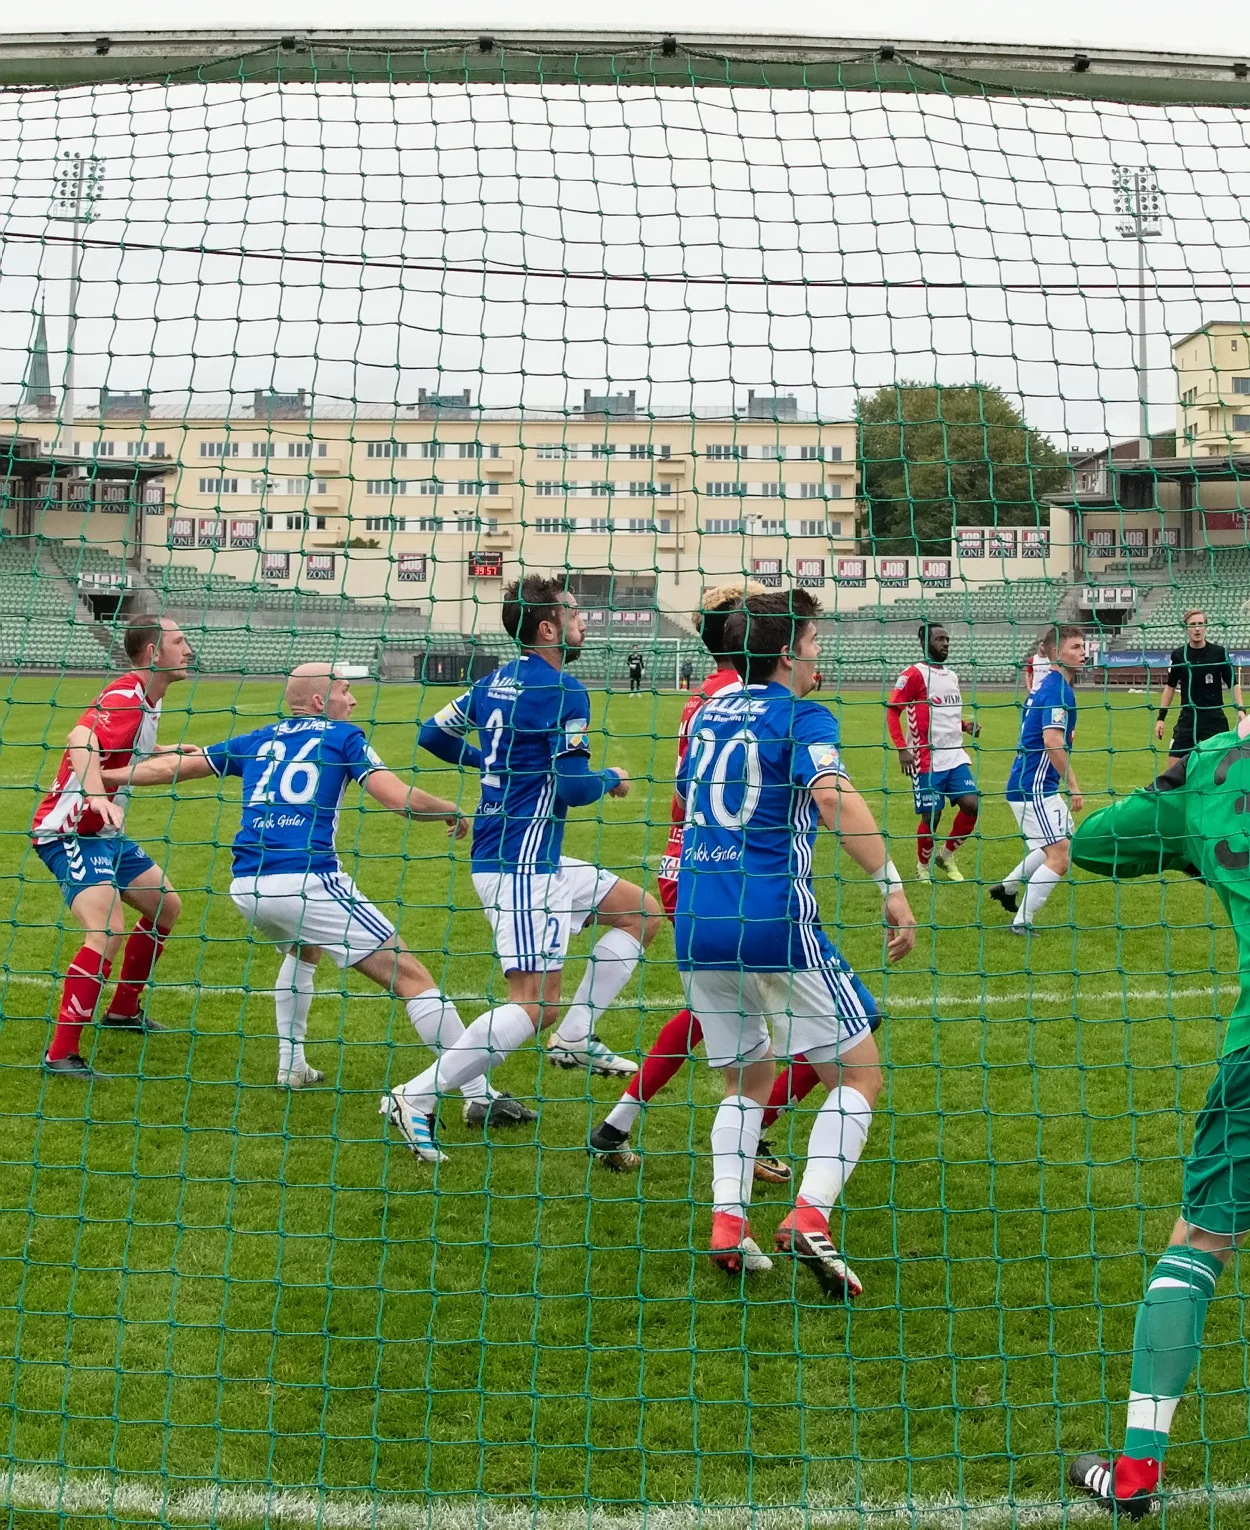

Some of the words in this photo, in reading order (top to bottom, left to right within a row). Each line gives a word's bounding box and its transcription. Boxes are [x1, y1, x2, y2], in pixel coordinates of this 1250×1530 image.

[104, 487, 125, 501] JOB
[146, 489, 161, 503] OB
[102, 503, 128, 513] ZONE
[233, 522, 254, 537] JOB
[230, 538, 258, 547] ZONE
[959, 531, 981, 548] JOB
[1090, 532, 1111, 546] JOB
[958, 549, 984, 557] ZONE
[989, 549, 1017, 558] ZONE
[1022, 549, 1050, 558] ZONE
[1088, 548, 1115, 557] ZONE
[265, 553, 285, 568] JOB
[309, 555, 331, 569] JOB
[400, 555, 422, 570] JOB
[756, 561, 778, 573] JOB
[262, 569, 289, 579] ZONE
[307, 571, 334, 579] ZONE
[799, 561, 820, 576] JOB
[840, 561, 862, 577] JOB
[883, 561, 904, 577] JOB
[925, 562, 946, 577] JOB
[398, 572, 425, 581] ZONE
[797, 578, 824, 587] ZONE
[838, 579, 866, 588] ZONE
[881, 579, 908, 588] ZONE
[923, 579, 951, 588] ZONE
[480, 708, 503, 788] 2
[249, 737, 322, 807] 26
[684, 728, 763, 831] 20
[1053, 809, 1062, 826] 7
[548, 917, 561, 948] 2
